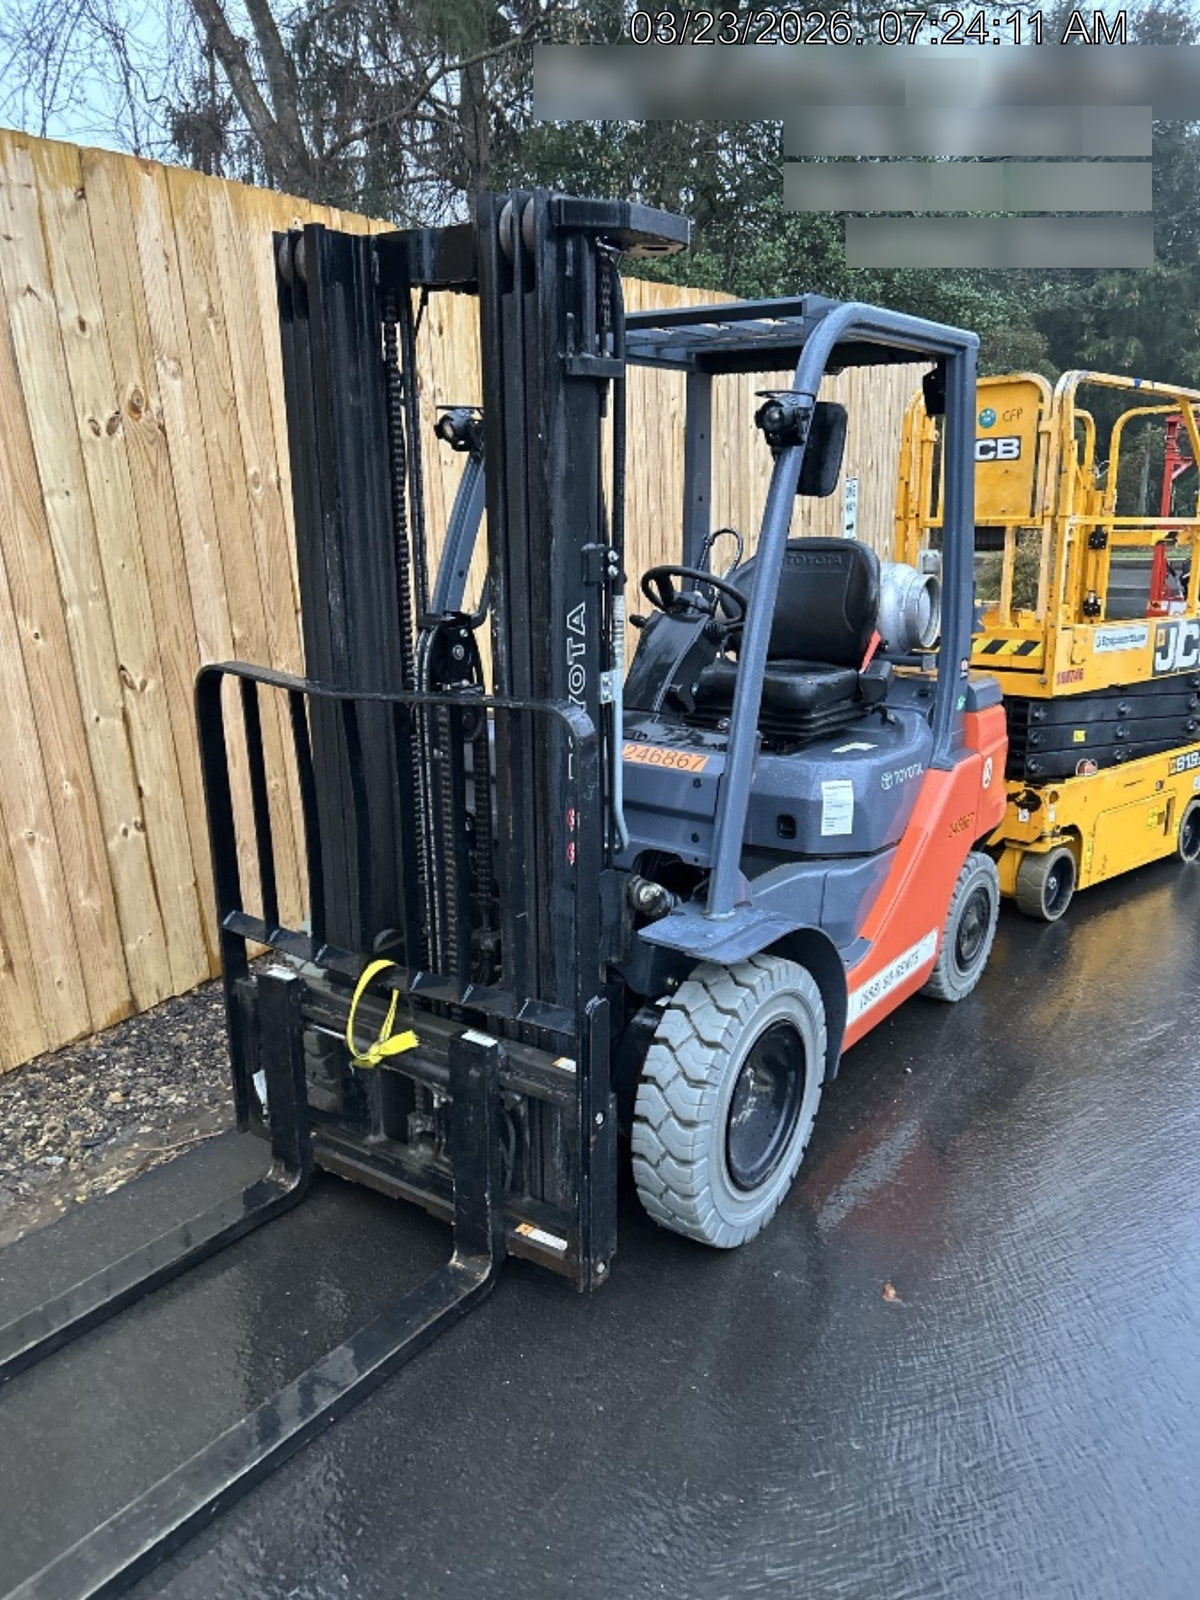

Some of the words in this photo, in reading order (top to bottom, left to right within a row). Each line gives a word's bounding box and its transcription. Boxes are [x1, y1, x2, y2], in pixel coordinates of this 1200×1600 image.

[975, 438, 1020, 461] CB
[1155, 618, 1200, 671] JC
[622, 744, 707, 770] 246867
[894, 763, 924, 785] TOYOTA
